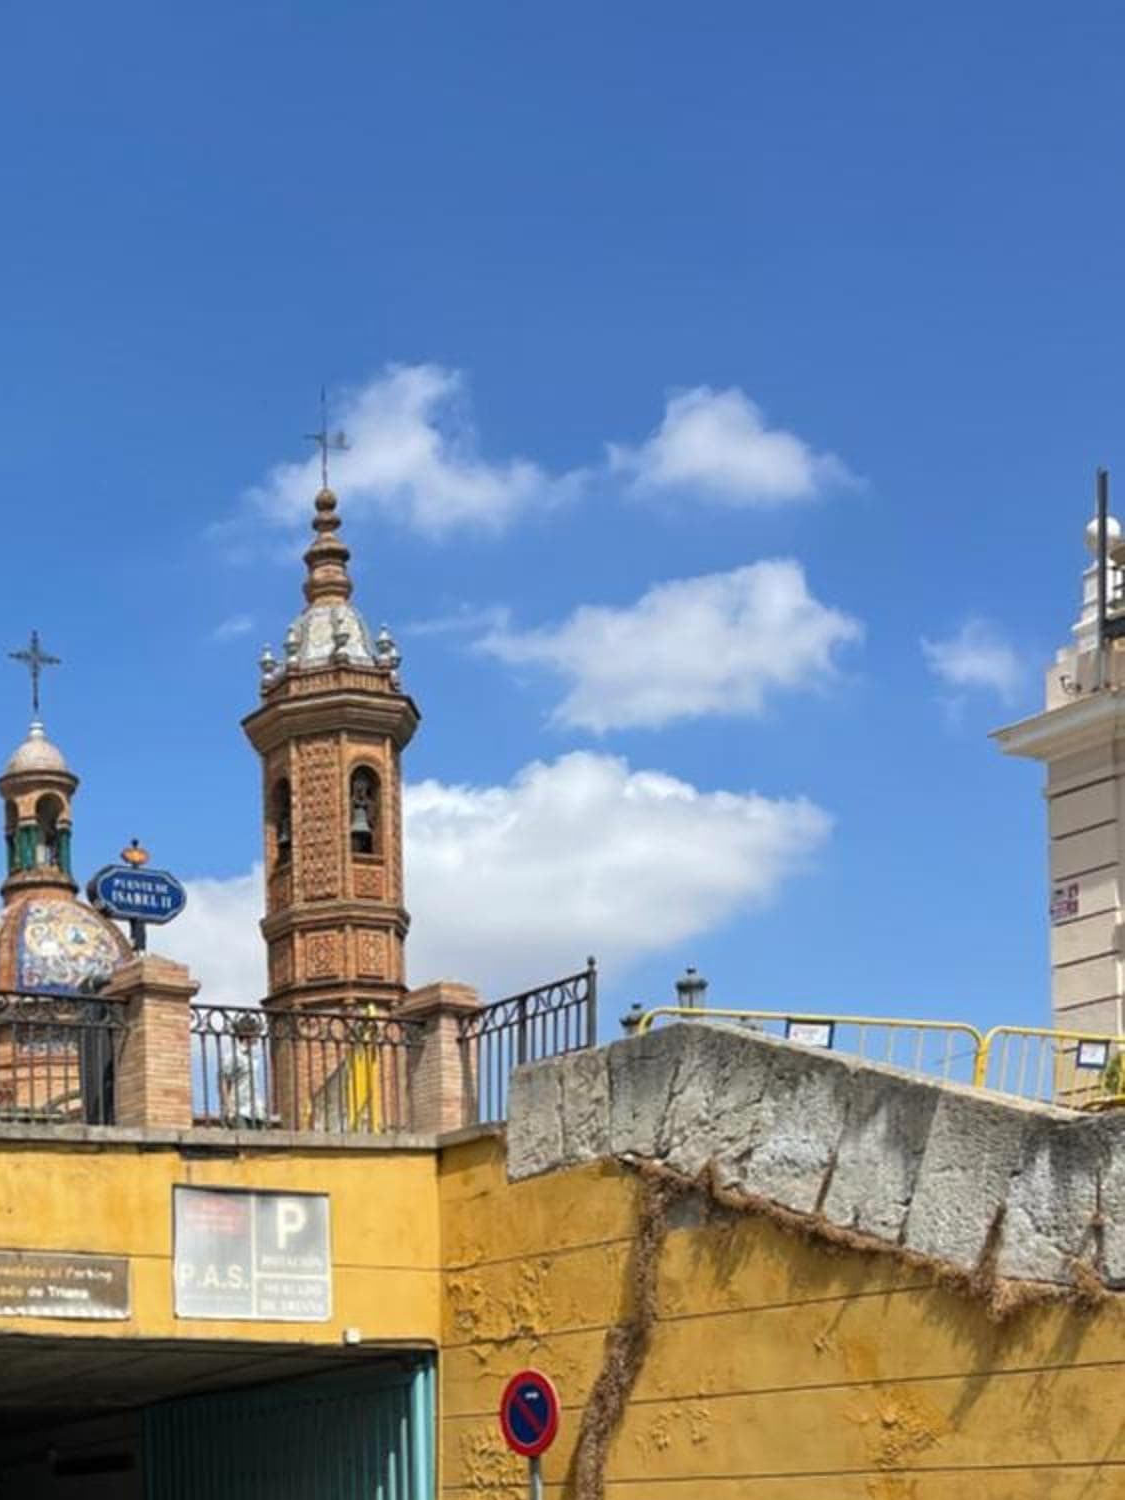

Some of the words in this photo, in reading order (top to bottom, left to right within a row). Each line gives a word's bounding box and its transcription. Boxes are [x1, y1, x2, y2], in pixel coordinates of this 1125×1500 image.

[111, 890, 158, 908] ISABEL
[160, 895, 172, 909] II
[276, 1200, 307, 1249] P
[65, 1265, 113, 1284] Parking
[179, 1264, 250, 1290] P.A.S.
[27, 1285, 44, 1298] de
[47, 1284, 89, 1299] Triana
